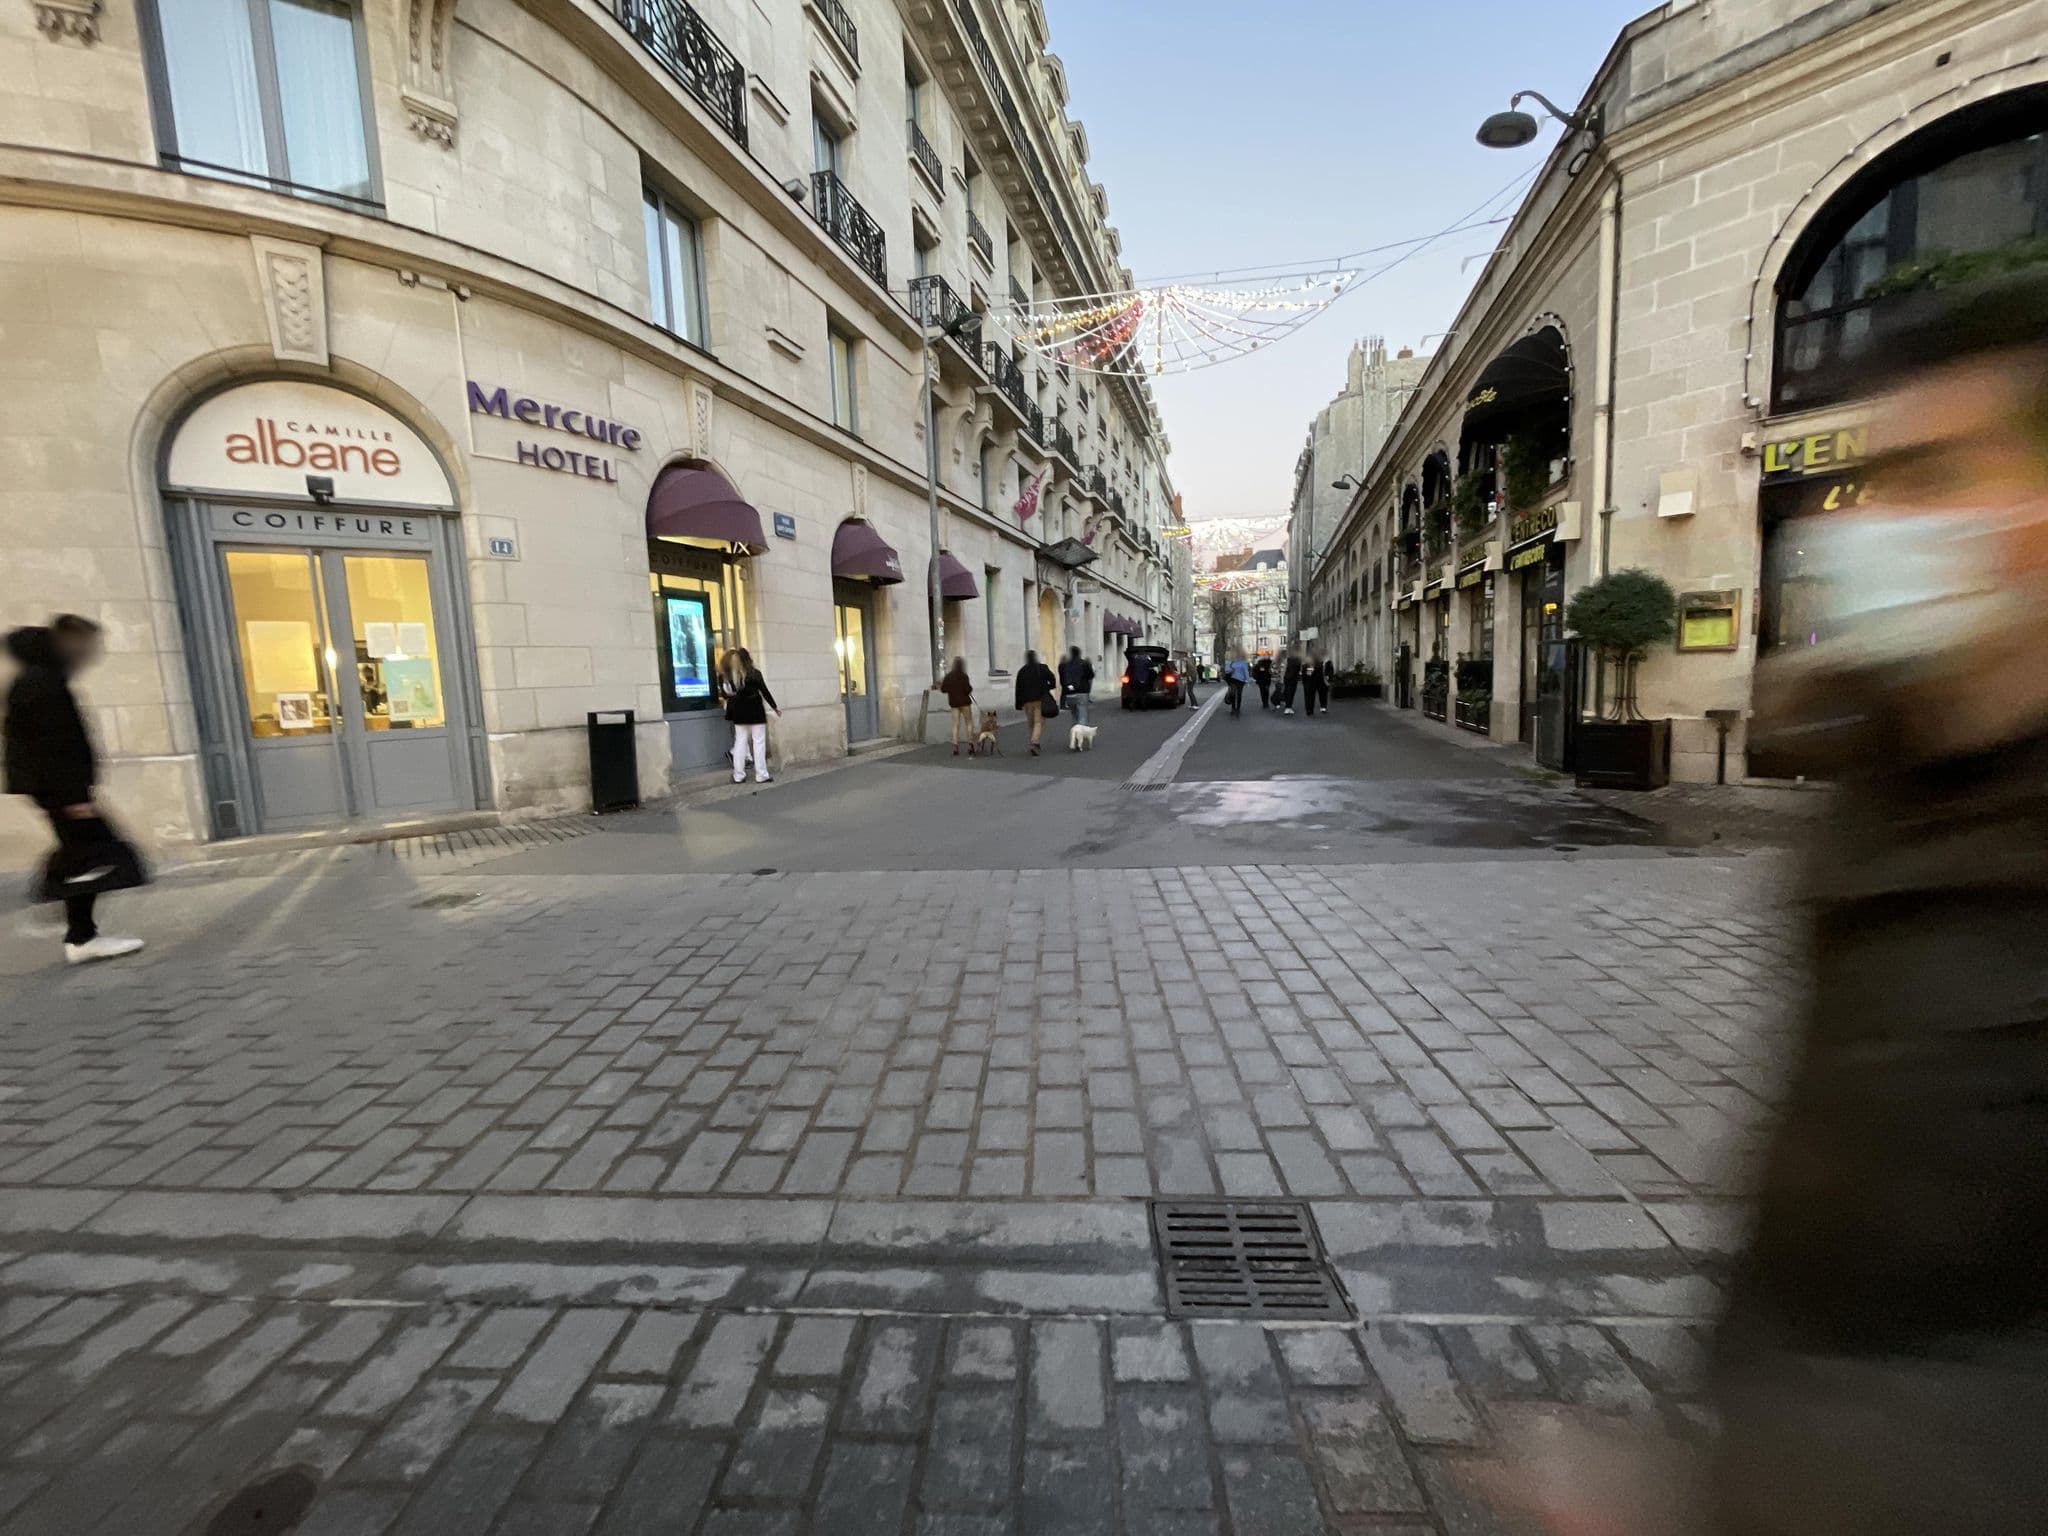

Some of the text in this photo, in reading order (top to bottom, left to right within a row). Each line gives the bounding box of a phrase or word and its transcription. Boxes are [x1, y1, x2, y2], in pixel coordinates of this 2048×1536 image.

[287, 422, 393, 442] CAMILLE
[467, 380, 642, 450] Mercure
[226, 418, 400, 476] albane
[517, 441, 617, 482] HOTEL
[232, 511, 414, 535] COIFFURE
